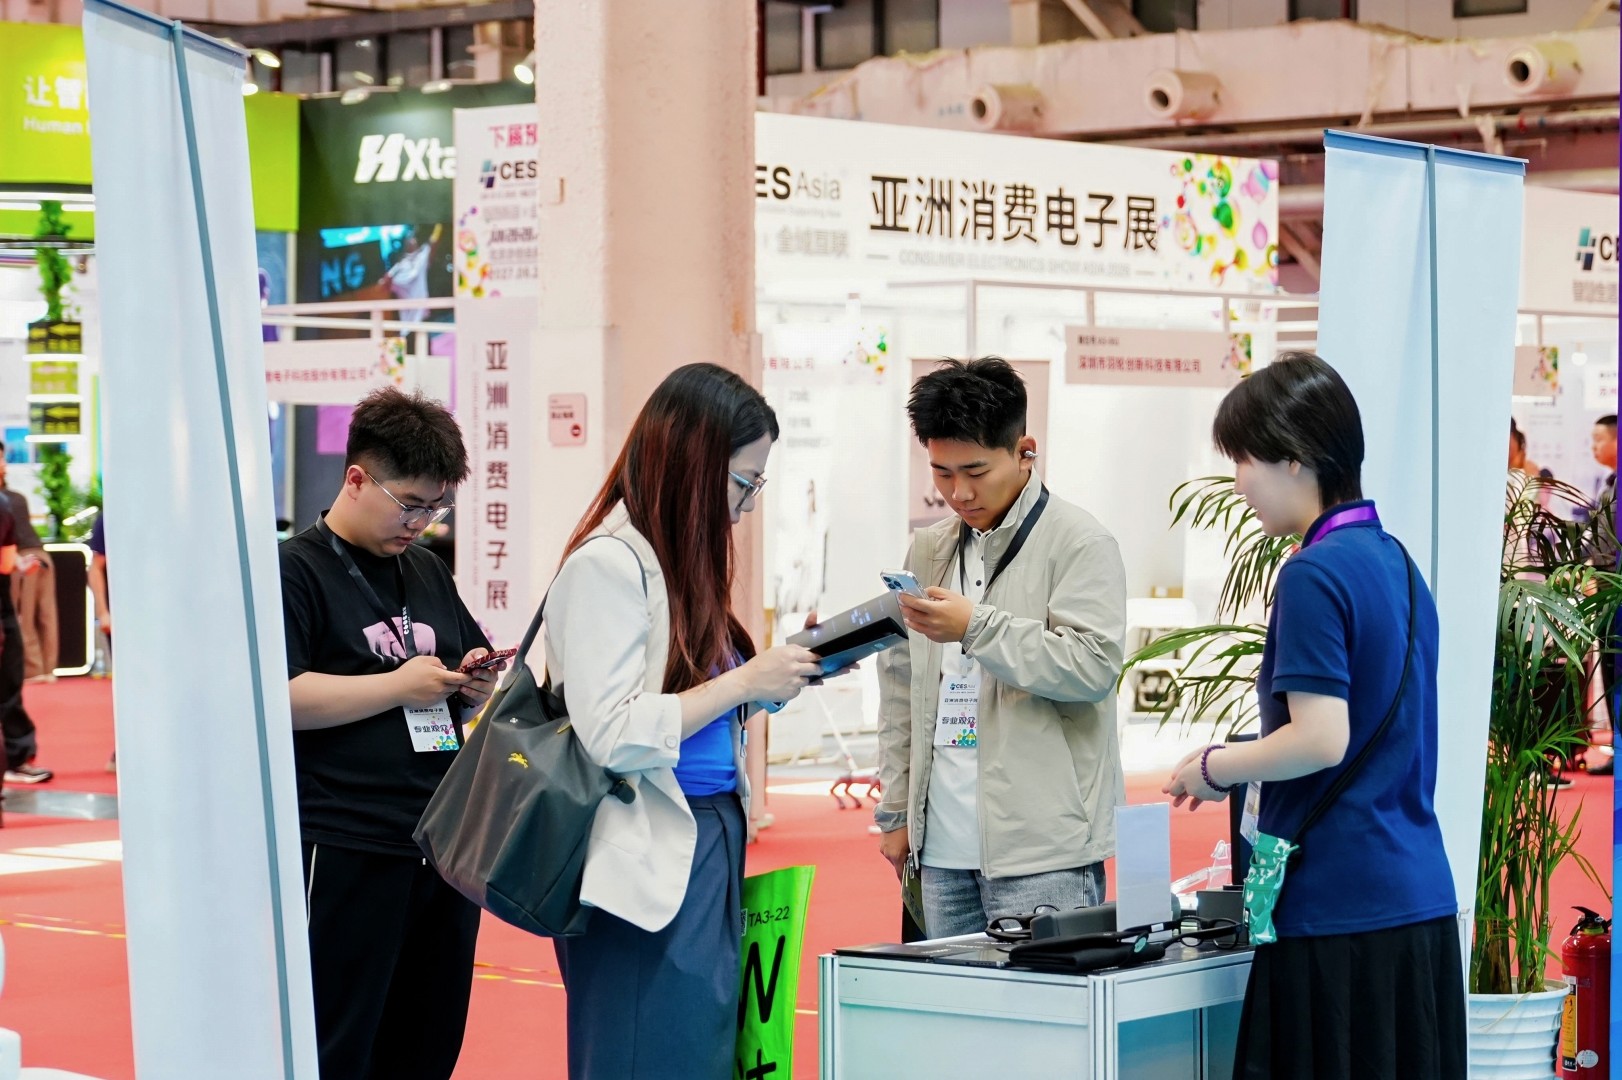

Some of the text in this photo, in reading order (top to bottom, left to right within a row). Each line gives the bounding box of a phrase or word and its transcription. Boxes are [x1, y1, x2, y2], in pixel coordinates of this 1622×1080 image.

[23, 75, 89, 110] 让智
[23, 116, 83, 135] Human
[500, 161, 538, 180] CES
[796, 171, 841, 201] Asia
[869, 174, 1158, 253] 亚洲消费电子展
[762, 357, 815, 371] 有限公司
[486, 340, 509, 610] 亚洲消费电子展
[414, 723, 449, 734] 专业观众
[942, 716, 976, 725] 专业观众
[748, 905, 790, 928] TA3-22
